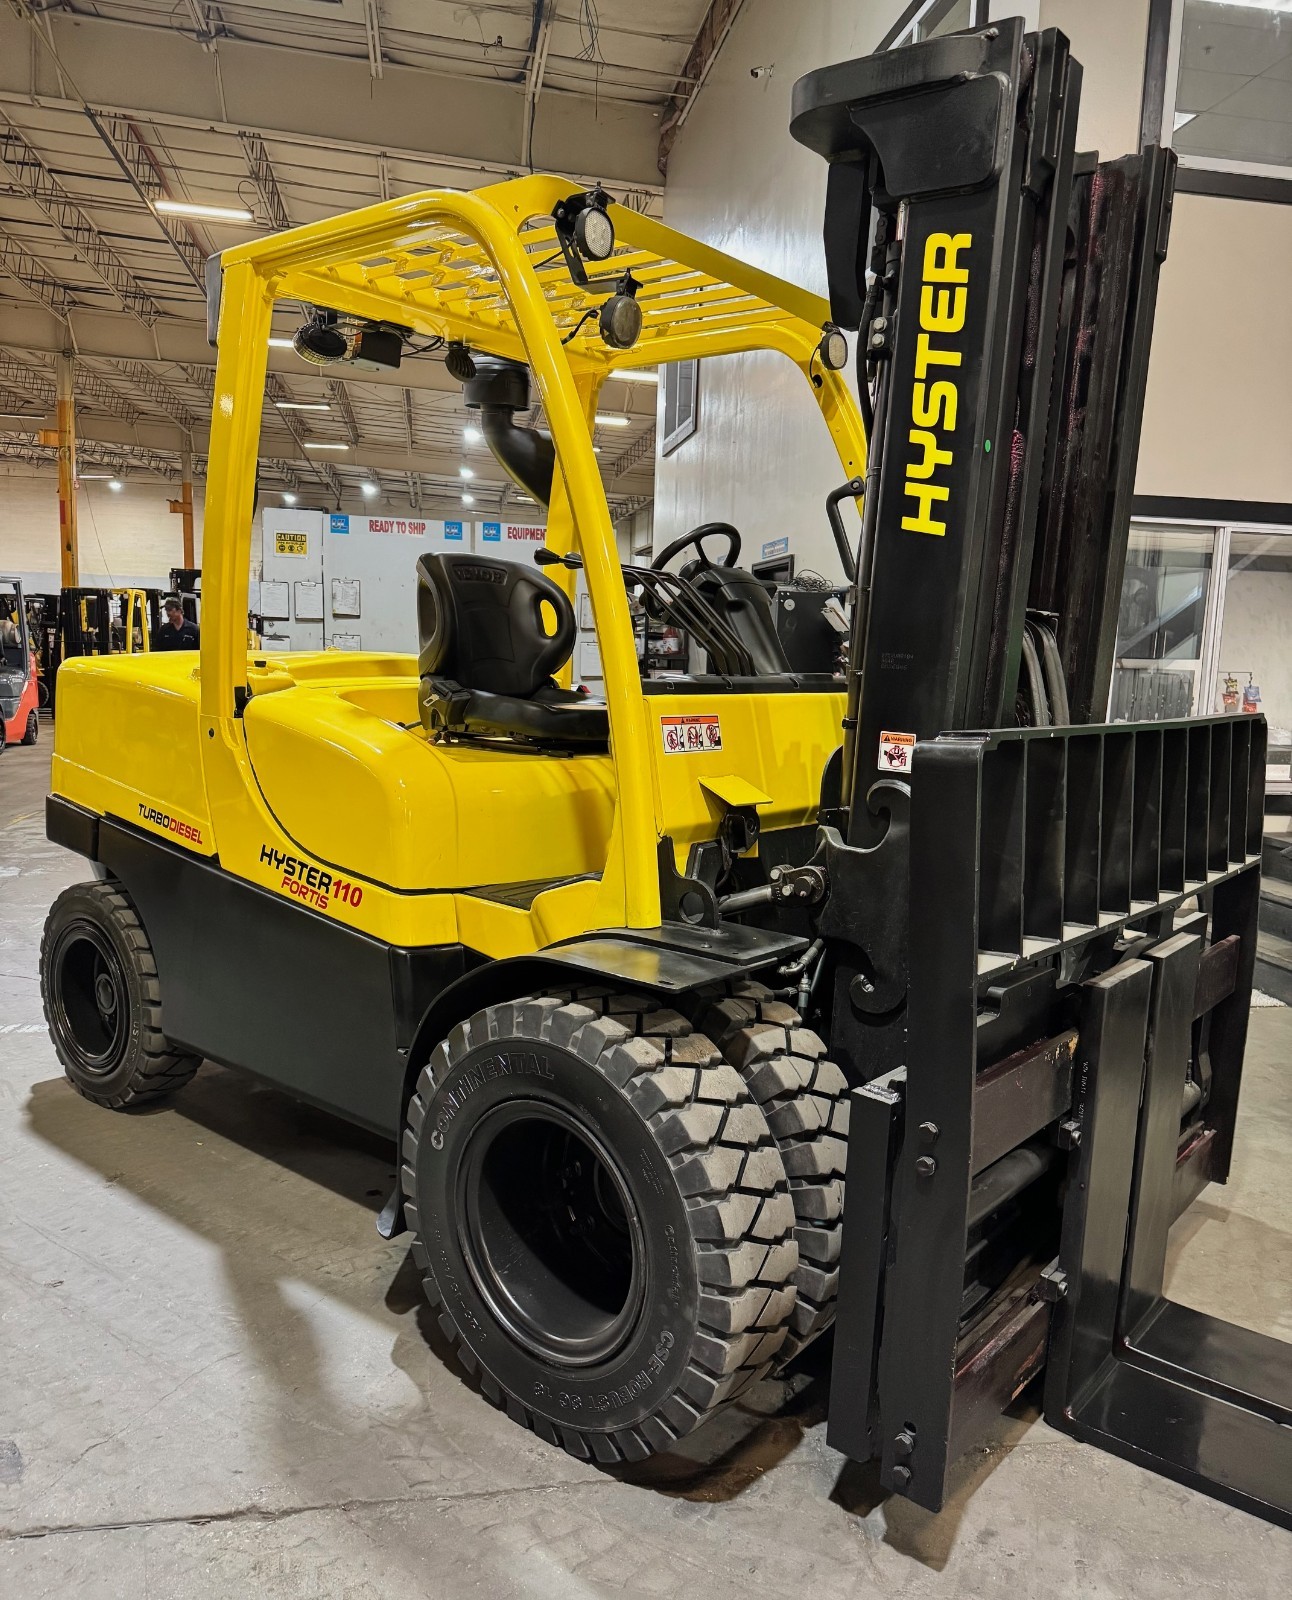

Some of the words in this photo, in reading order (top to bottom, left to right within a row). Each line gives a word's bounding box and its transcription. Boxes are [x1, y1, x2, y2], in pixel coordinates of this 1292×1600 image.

[900, 232, 972, 537] HYSTER
[276, 533, 307, 542] CAUTION
[369, 519, 395, 534] READY
[396, 521, 406, 534] TO
[408, 522, 426, 535] SHIP
[138, 803, 203, 845] TURBODIESEL
[259, 844, 332, 895] HYSTER
[332, 879, 363, 908] 110
[281, 876, 329, 910] FORTIS
[431, 1052, 555, 1150] CONTINENTAL
